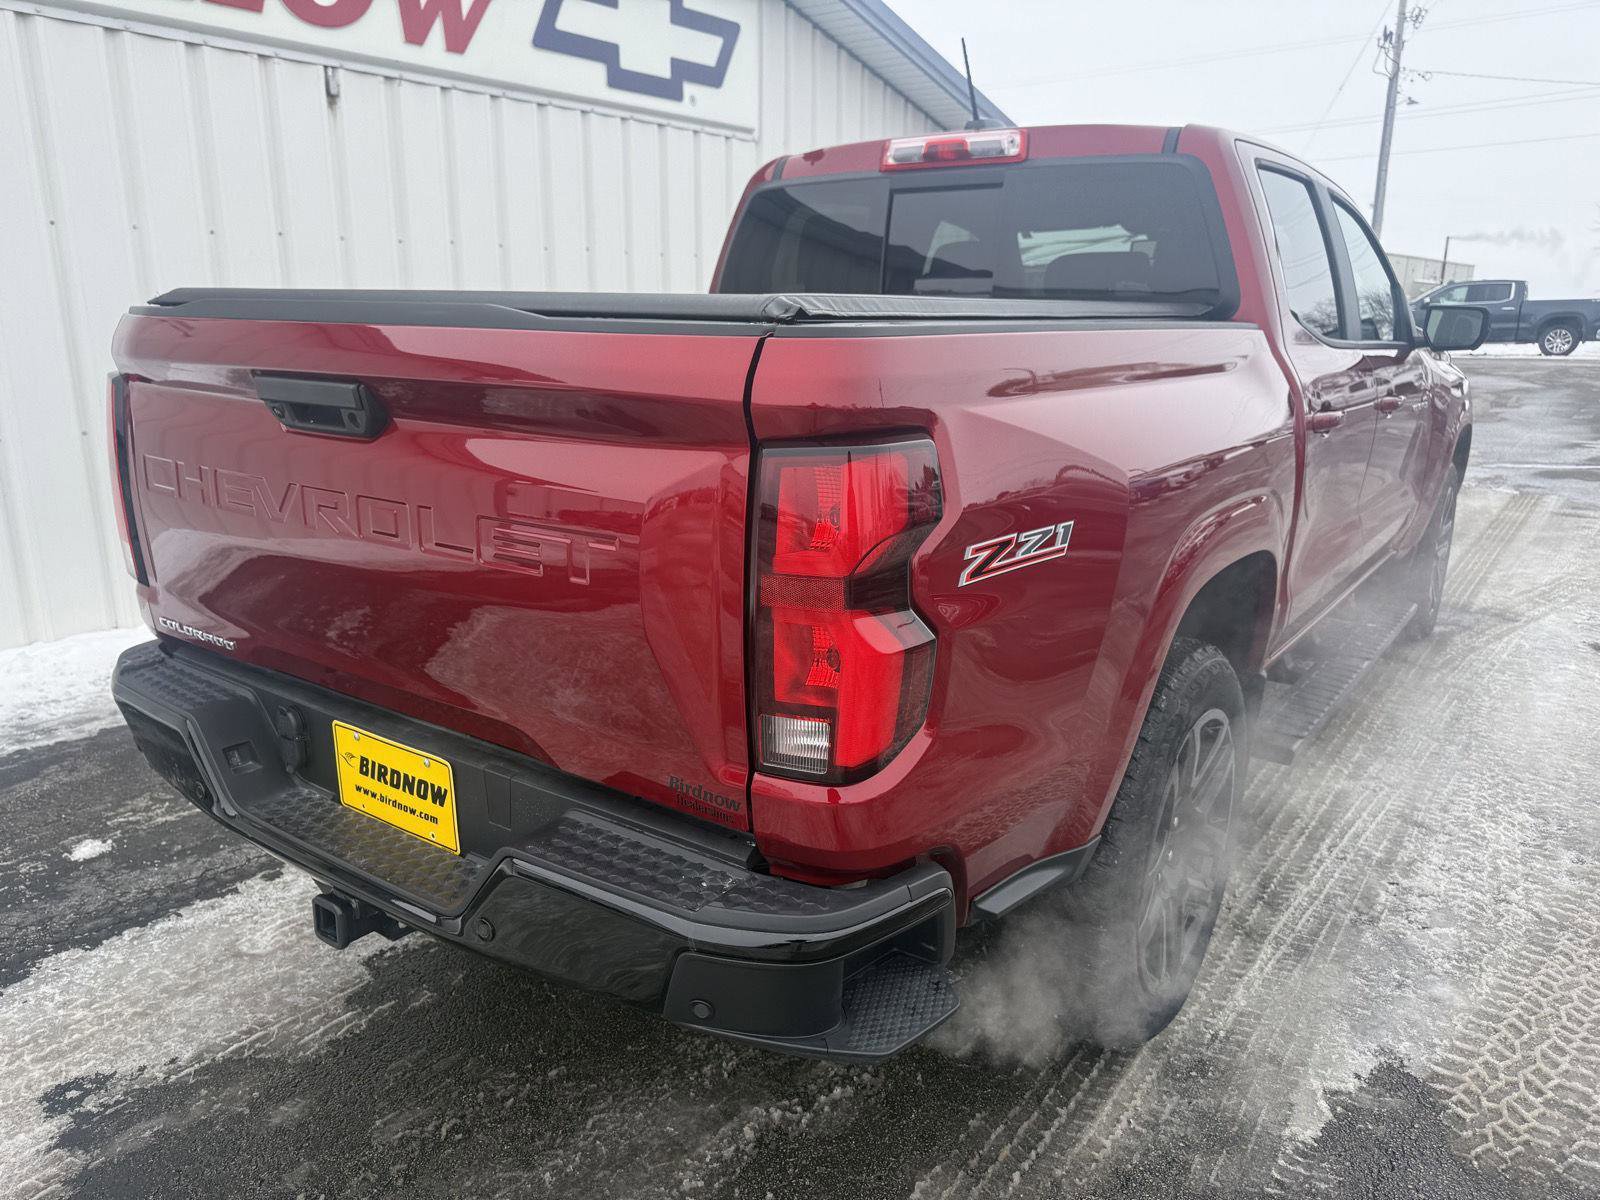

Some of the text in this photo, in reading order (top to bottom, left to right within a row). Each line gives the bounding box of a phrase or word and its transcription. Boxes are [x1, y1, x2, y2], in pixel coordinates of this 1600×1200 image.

[142, 453, 622, 586] CHEVROLET
[958, 520, 1074, 588] Z71
[158, 616, 236, 651] COLORADO
[354, 783, 439, 825] www.birdnow.com
[359, 755, 448, 808] BIRDNOW
[669, 775, 742, 812] Birdnow
